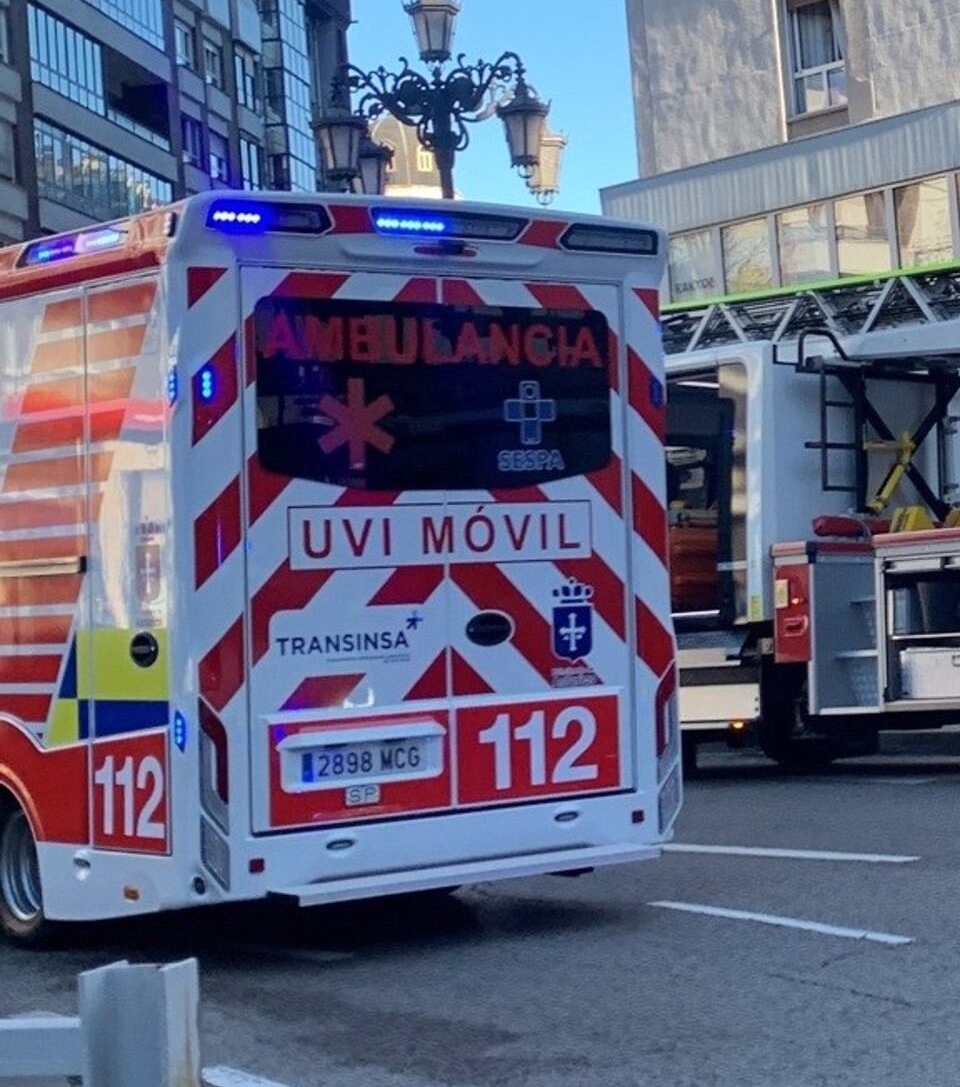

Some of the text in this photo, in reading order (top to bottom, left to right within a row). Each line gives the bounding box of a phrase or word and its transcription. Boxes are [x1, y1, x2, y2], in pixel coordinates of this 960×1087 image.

[263, 310, 601, 366] AMBULANCIA
[498, 449, 566, 471] SESPA
[303, 505, 580, 559] UVI MÓVIL
[276, 630, 409, 656] TRANSINSA
[318, 746, 421, 777] 2898 MCG
[479, 705, 598, 790] 112
[94, 755, 165, 839] 112
[349, 787, 377, 804] SP
